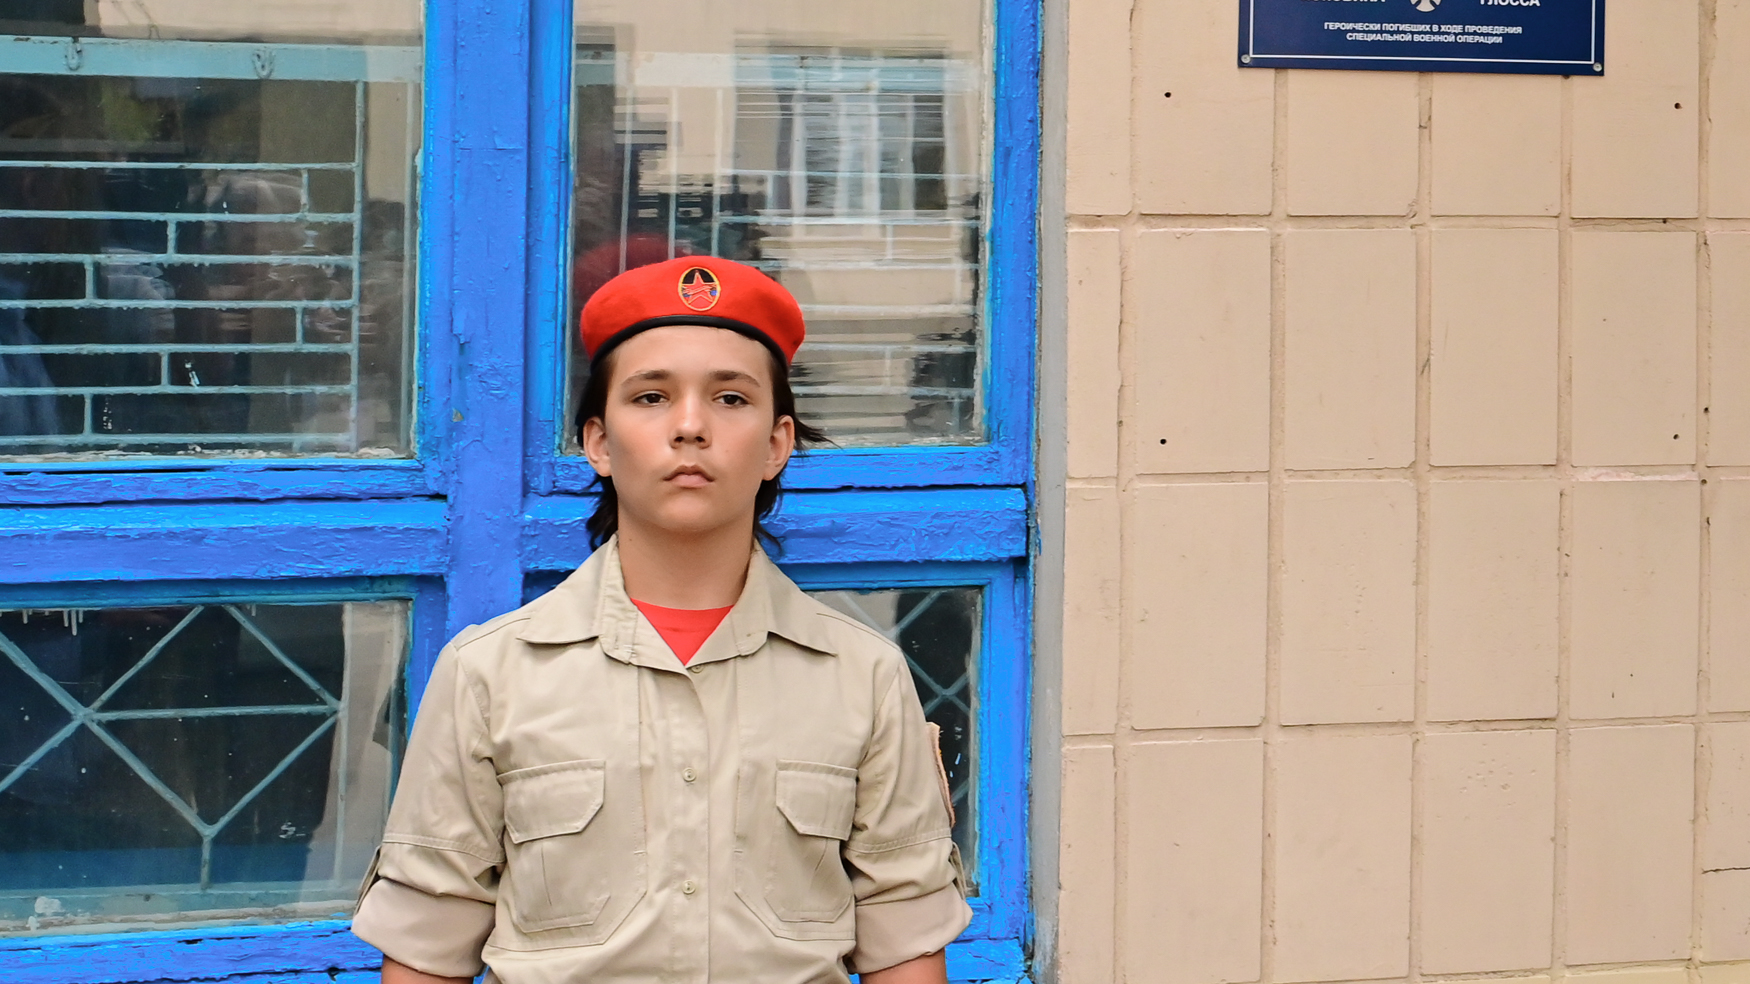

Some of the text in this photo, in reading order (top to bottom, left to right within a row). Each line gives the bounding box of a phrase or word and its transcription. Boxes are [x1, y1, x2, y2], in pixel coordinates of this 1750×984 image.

[1324, 22, 1523, 35] ГЕРОИЧЕСКИ ПОГИБШИХ В ХОДЕ ПРОВЕДЕНИЯ
[1346, 32, 1503, 44] СПЕЦИАЛЬНОЙ ВОЕННОЙ ОПЕРАЦИИ
